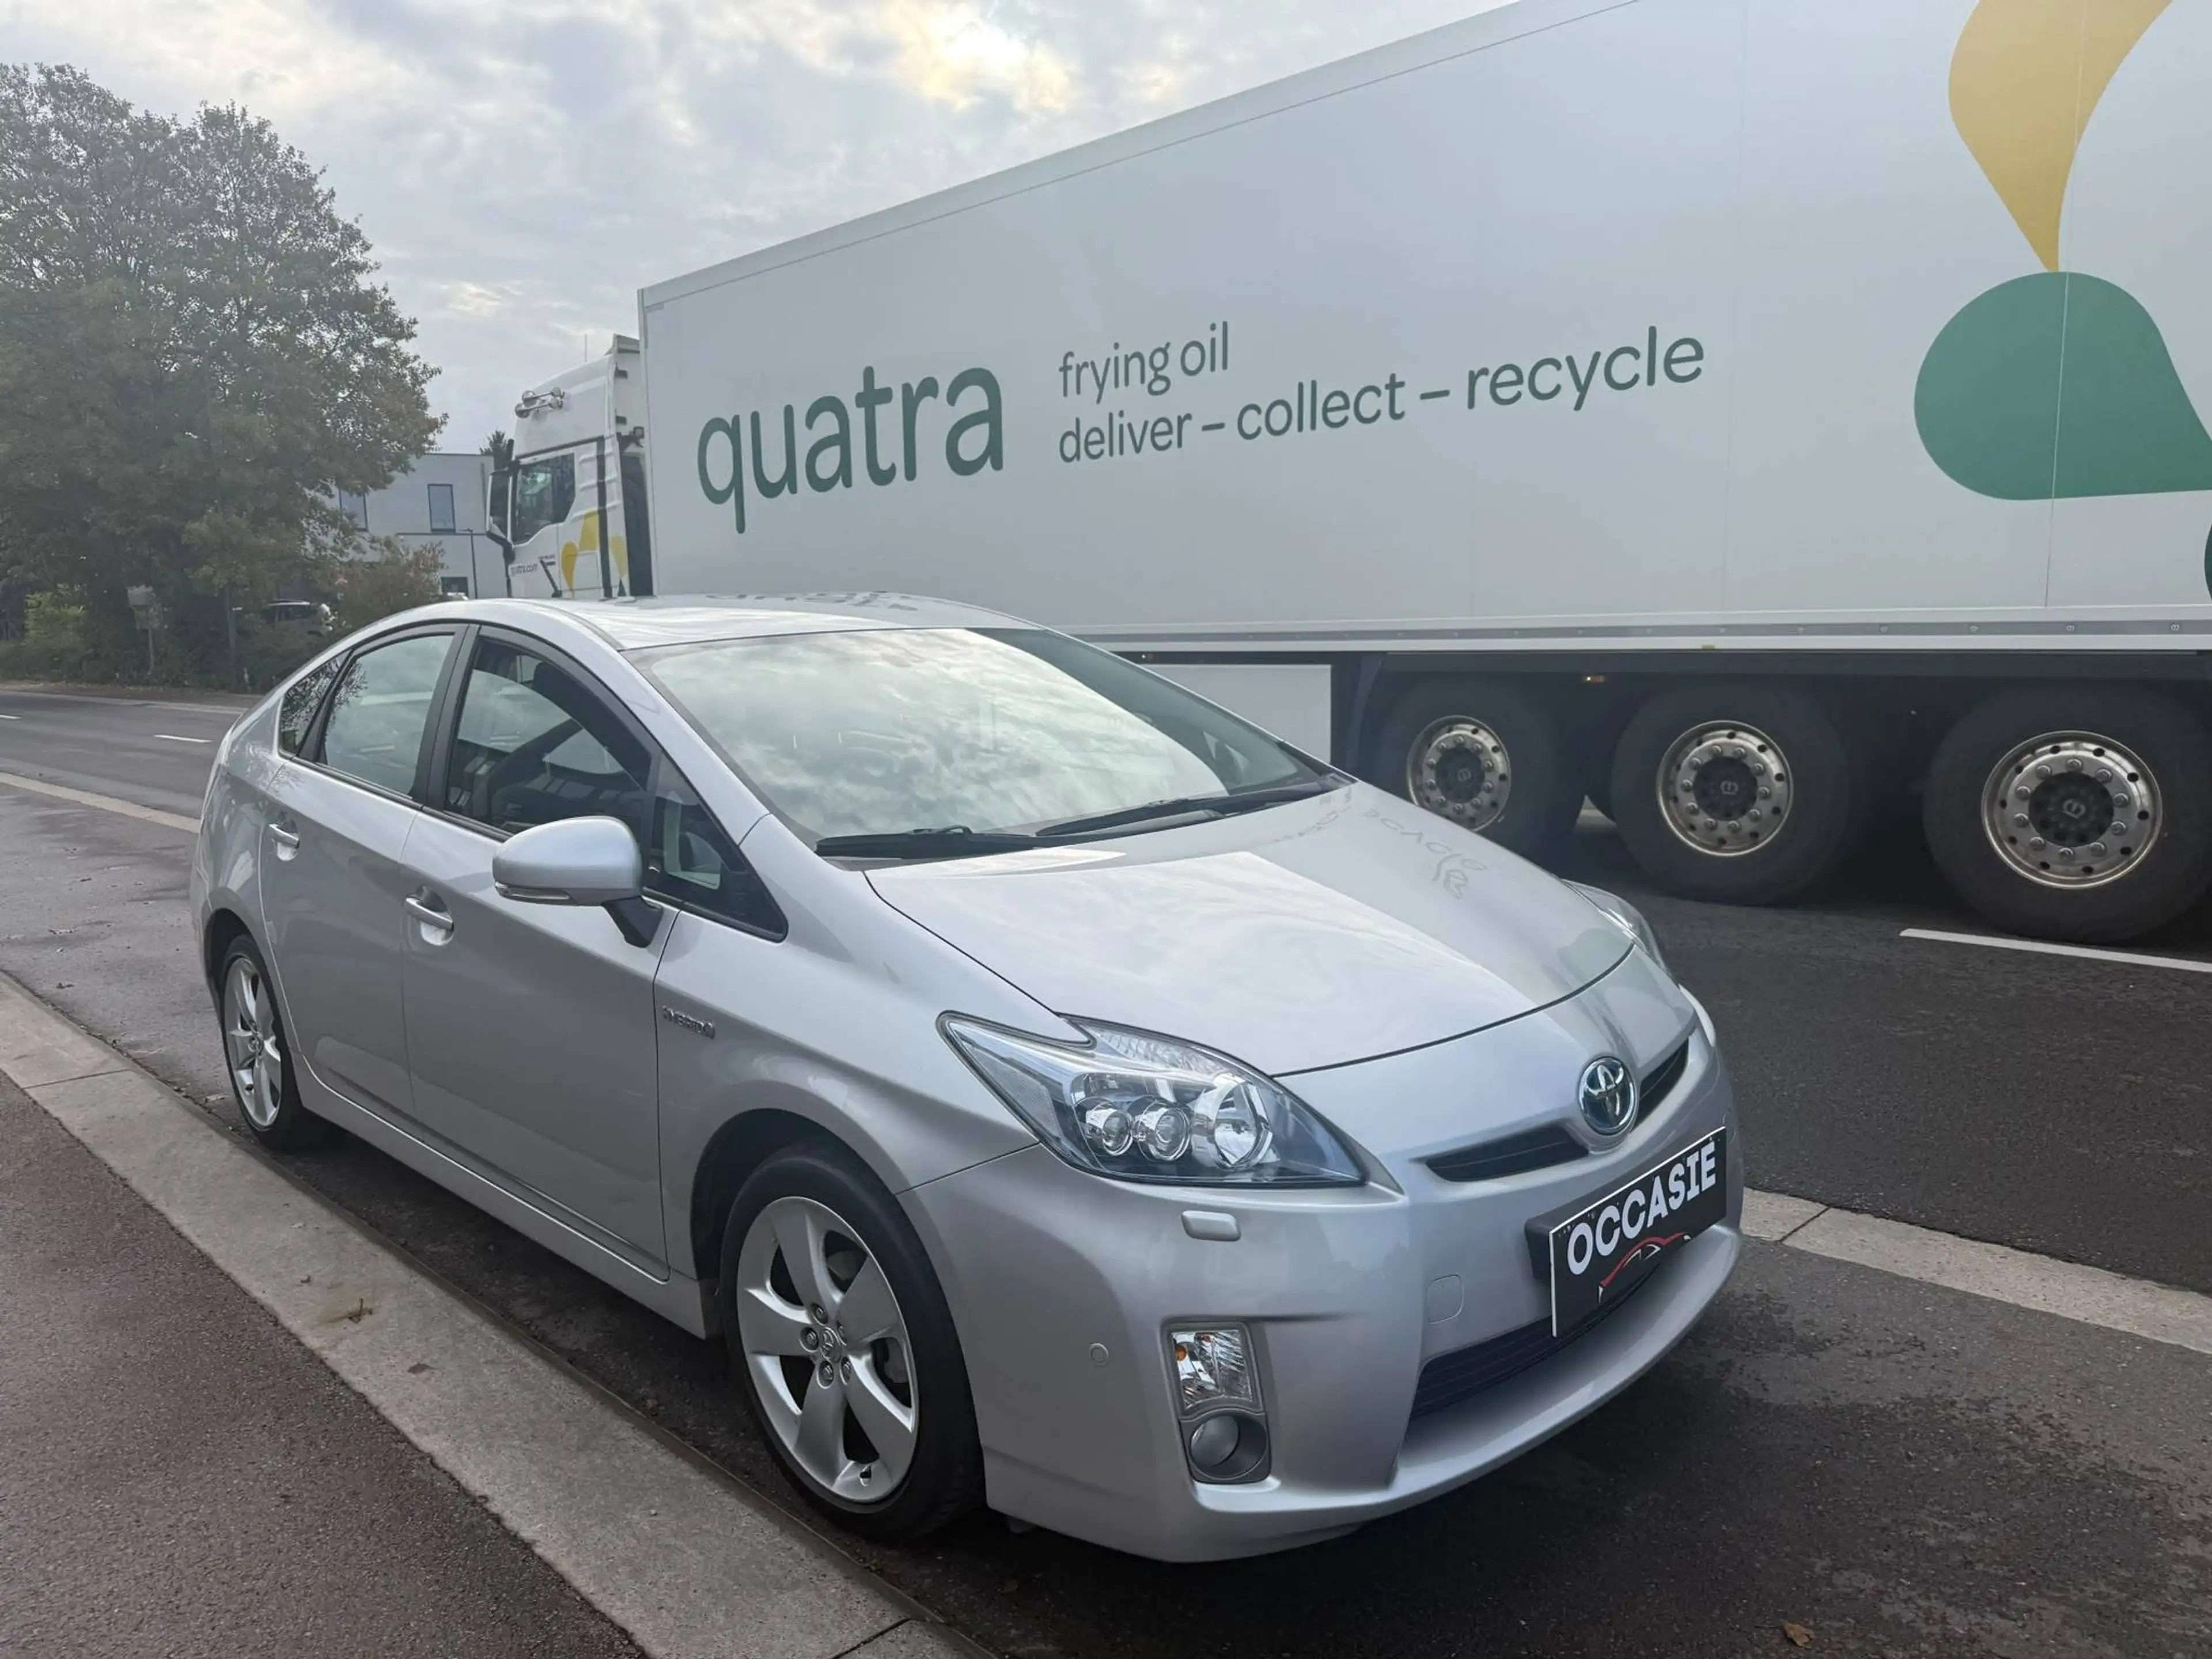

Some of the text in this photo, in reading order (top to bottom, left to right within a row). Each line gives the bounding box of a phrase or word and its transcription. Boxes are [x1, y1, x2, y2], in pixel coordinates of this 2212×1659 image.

[1059, 321, 1228, 404] frying oil
[1059, 410, 1192, 463] deliver
[1237, 373, 1405, 440] collect
[1467, 325, 1704, 411] recycle
[698, 366, 1003, 534] quatra
[1567, 1142, 1715, 1275] OCCASIE
